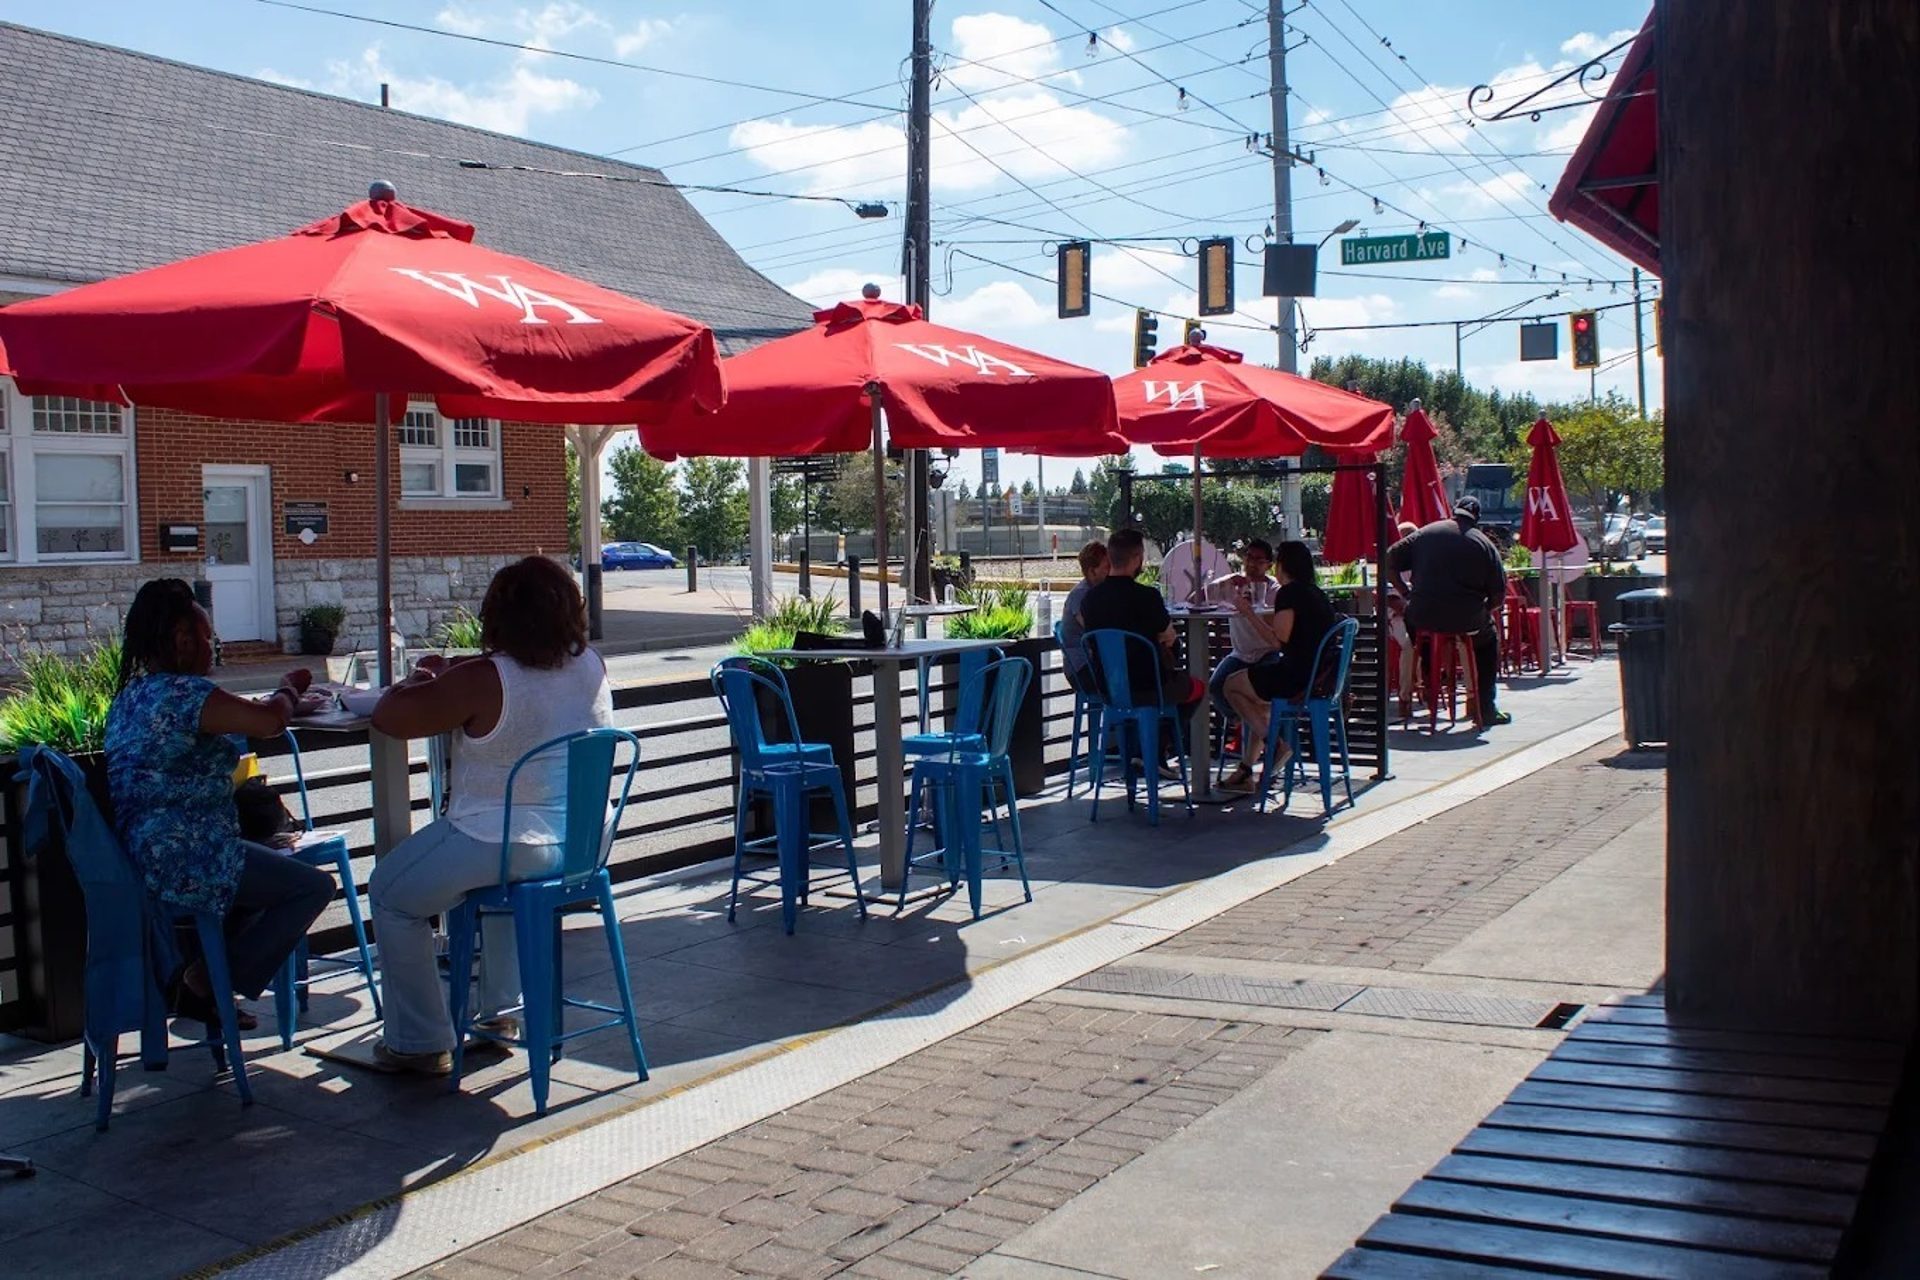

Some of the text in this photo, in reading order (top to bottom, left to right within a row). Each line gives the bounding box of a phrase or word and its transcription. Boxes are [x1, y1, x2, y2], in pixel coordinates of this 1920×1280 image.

[1345, 238, 1446, 262] Harvard Ave
[389, 267, 603, 323] WA
[891, 343, 1036, 376] WA
[1142, 380, 1210, 412] WA
[1528, 485, 1560, 522] WA
